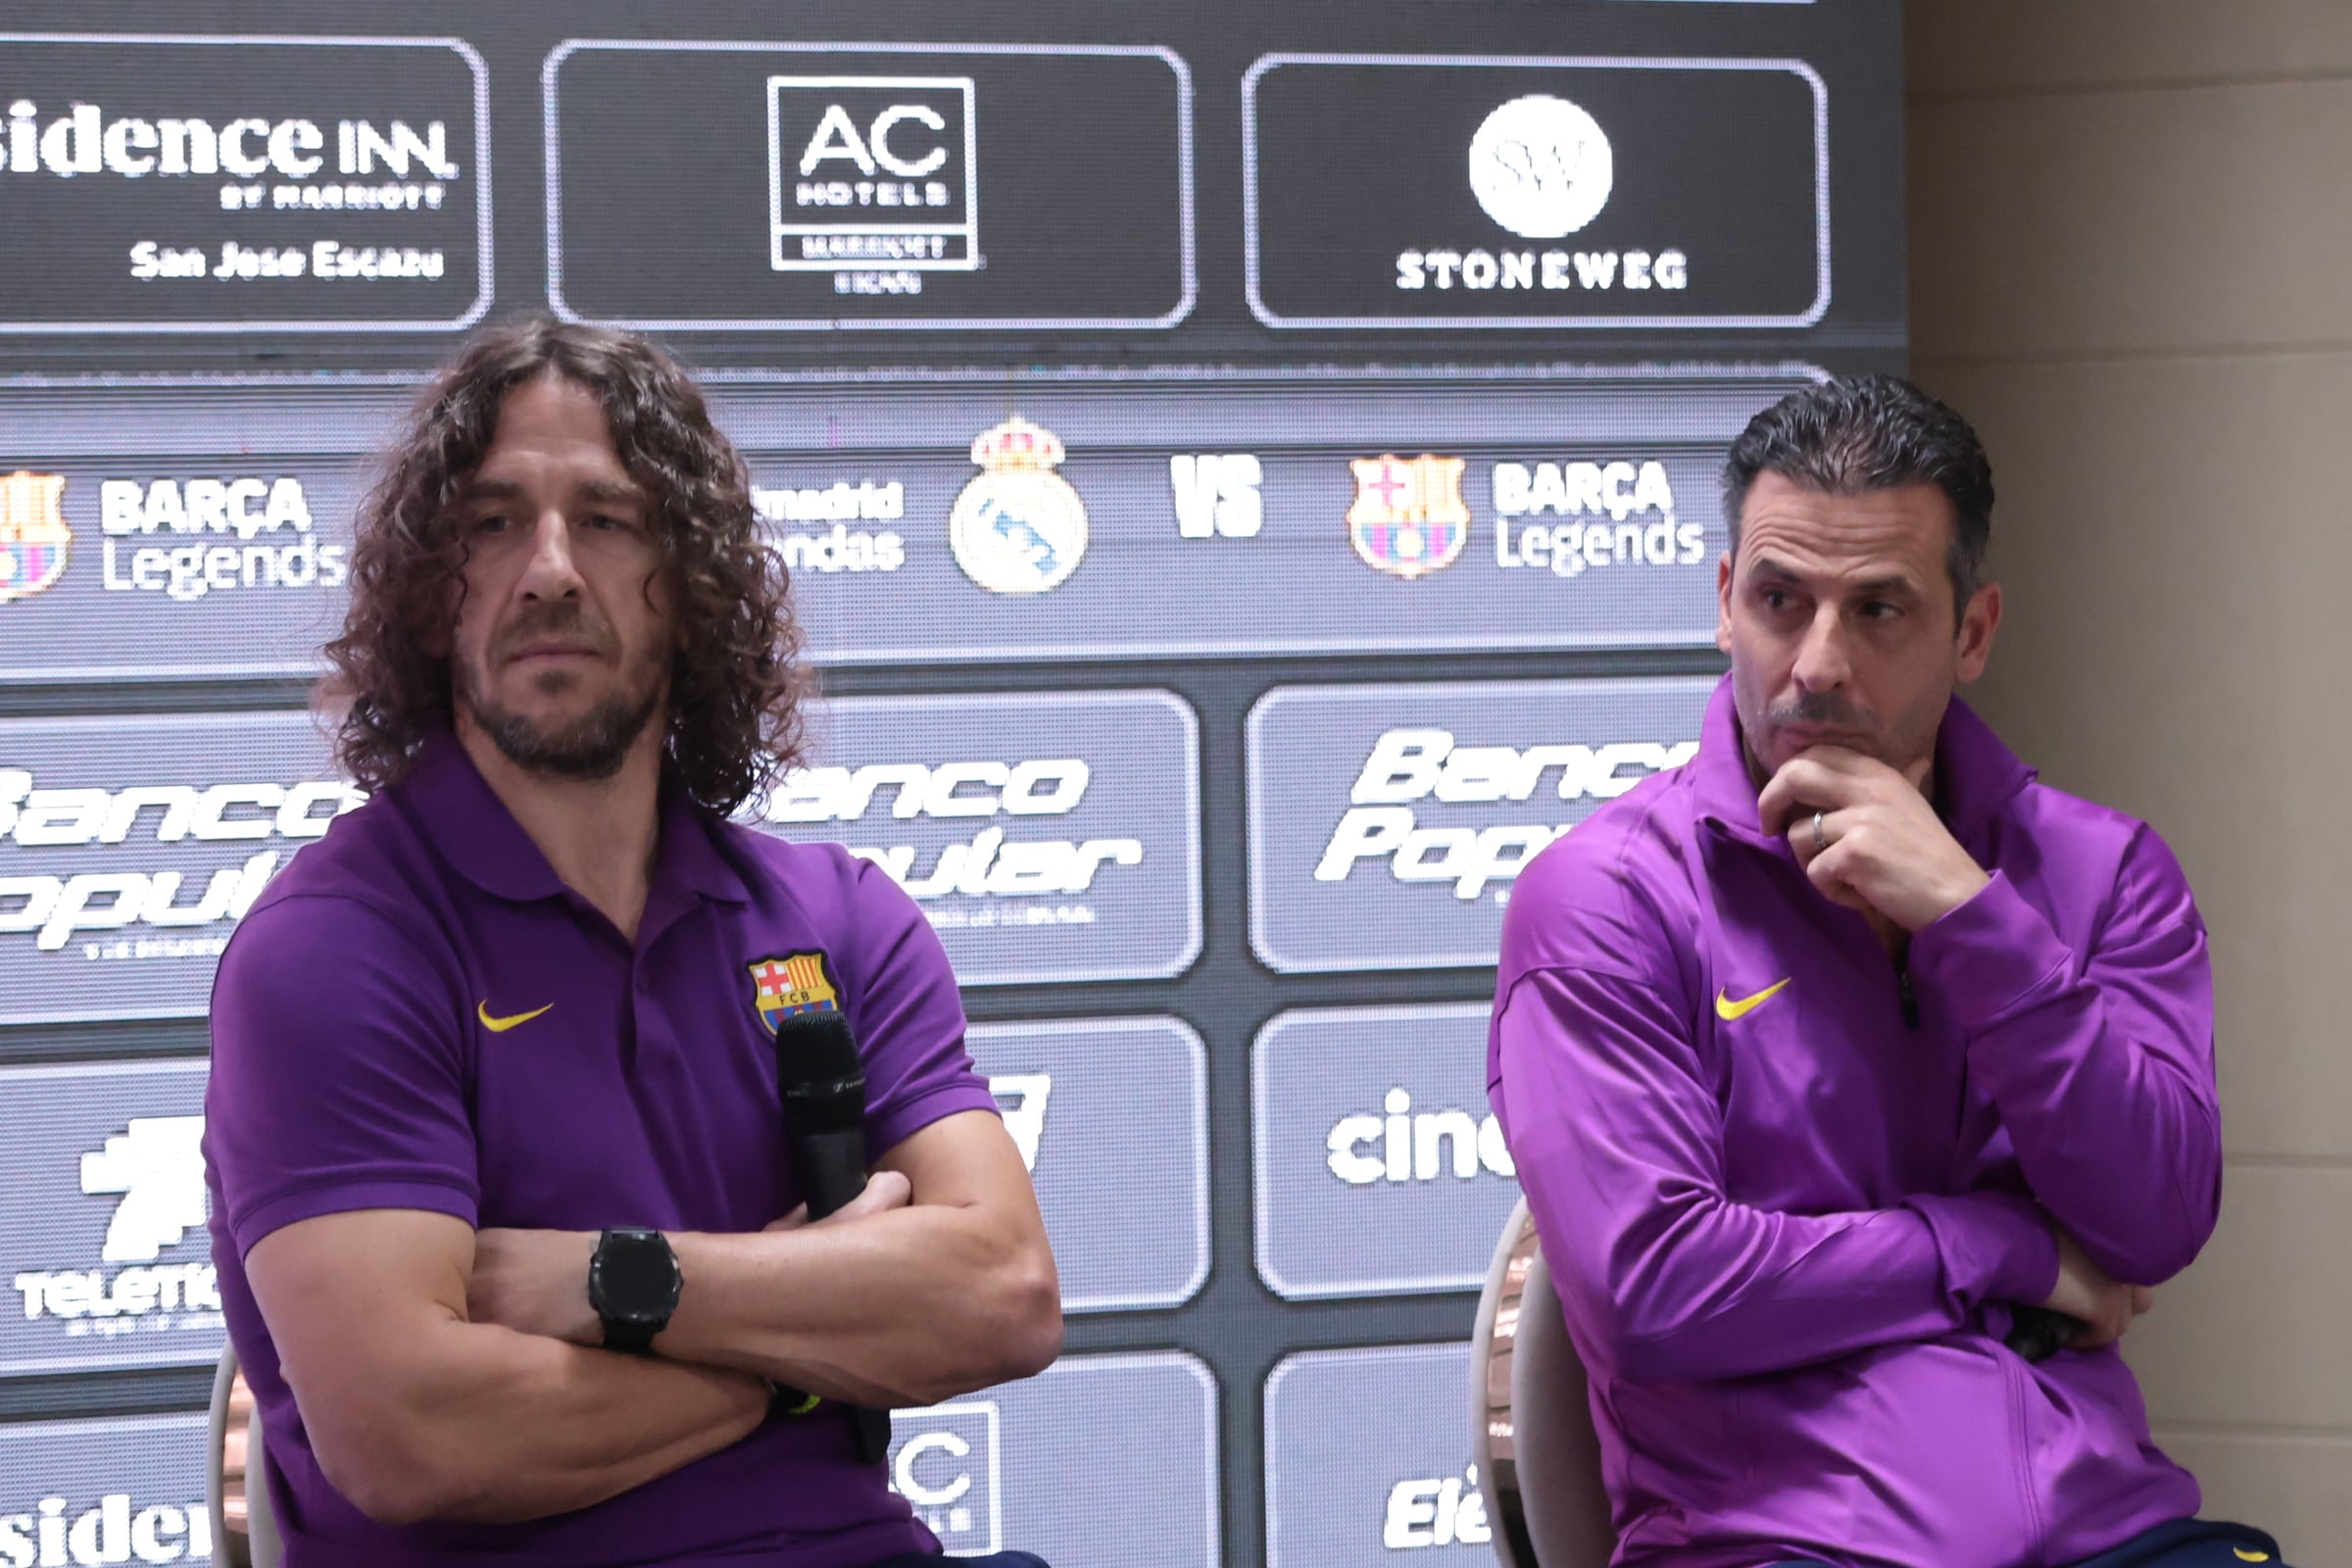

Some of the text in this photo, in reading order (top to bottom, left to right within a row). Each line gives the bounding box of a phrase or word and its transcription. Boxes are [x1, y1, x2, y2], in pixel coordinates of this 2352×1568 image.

[0, 99, 323, 177] idence
[799, 104, 948, 176] AC
[130, 241, 206, 279] San
[1396, 249, 1687, 289] STONEWEG
[101, 478, 313, 539] BARÇA
[1170, 454, 1262, 538] VS
[1494, 461, 1675, 521] BARÇA
[103, 534, 349, 600] Legends
[762, 523, 905, 572] ndas
[1496, 514, 1704, 577] Legends
[762, 760, 1089, 823] anco
[849, 826, 1143, 896] ular
[888, 1432, 971, 1505] C
